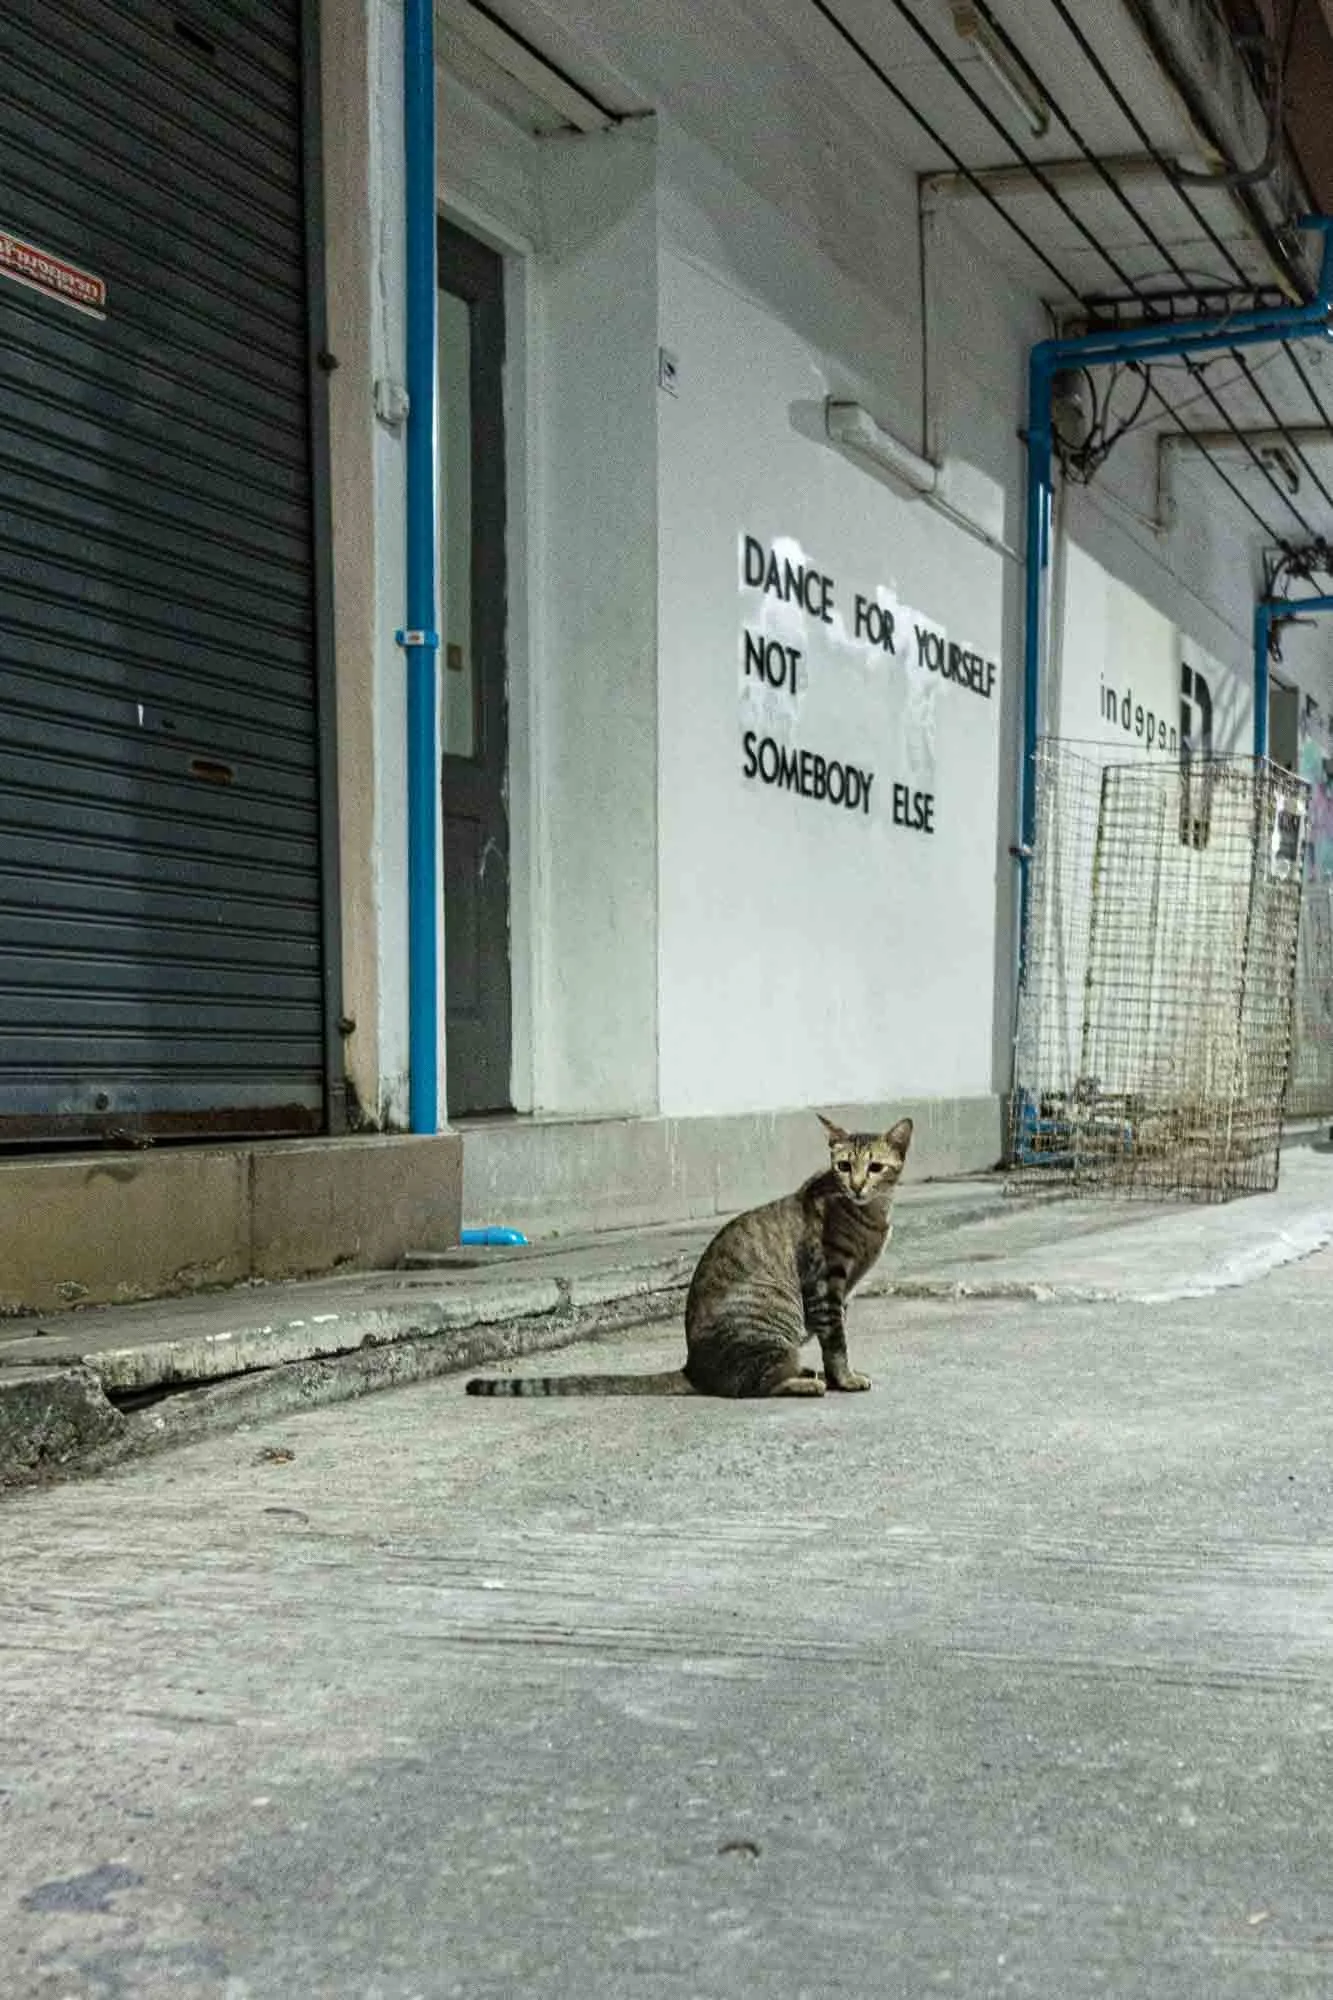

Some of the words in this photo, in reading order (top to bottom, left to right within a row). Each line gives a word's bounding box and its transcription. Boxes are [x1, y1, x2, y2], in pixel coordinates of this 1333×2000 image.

[744, 535, 834, 624] DANCE
[854, 593, 896, 656] FOR
[914, 624, 997, 699] YOURSELF
[744, 629, 802, 695] NOT
[743, 730, 874, 815] SOMEBODY
[892, 782, 935, 834] ELSE
